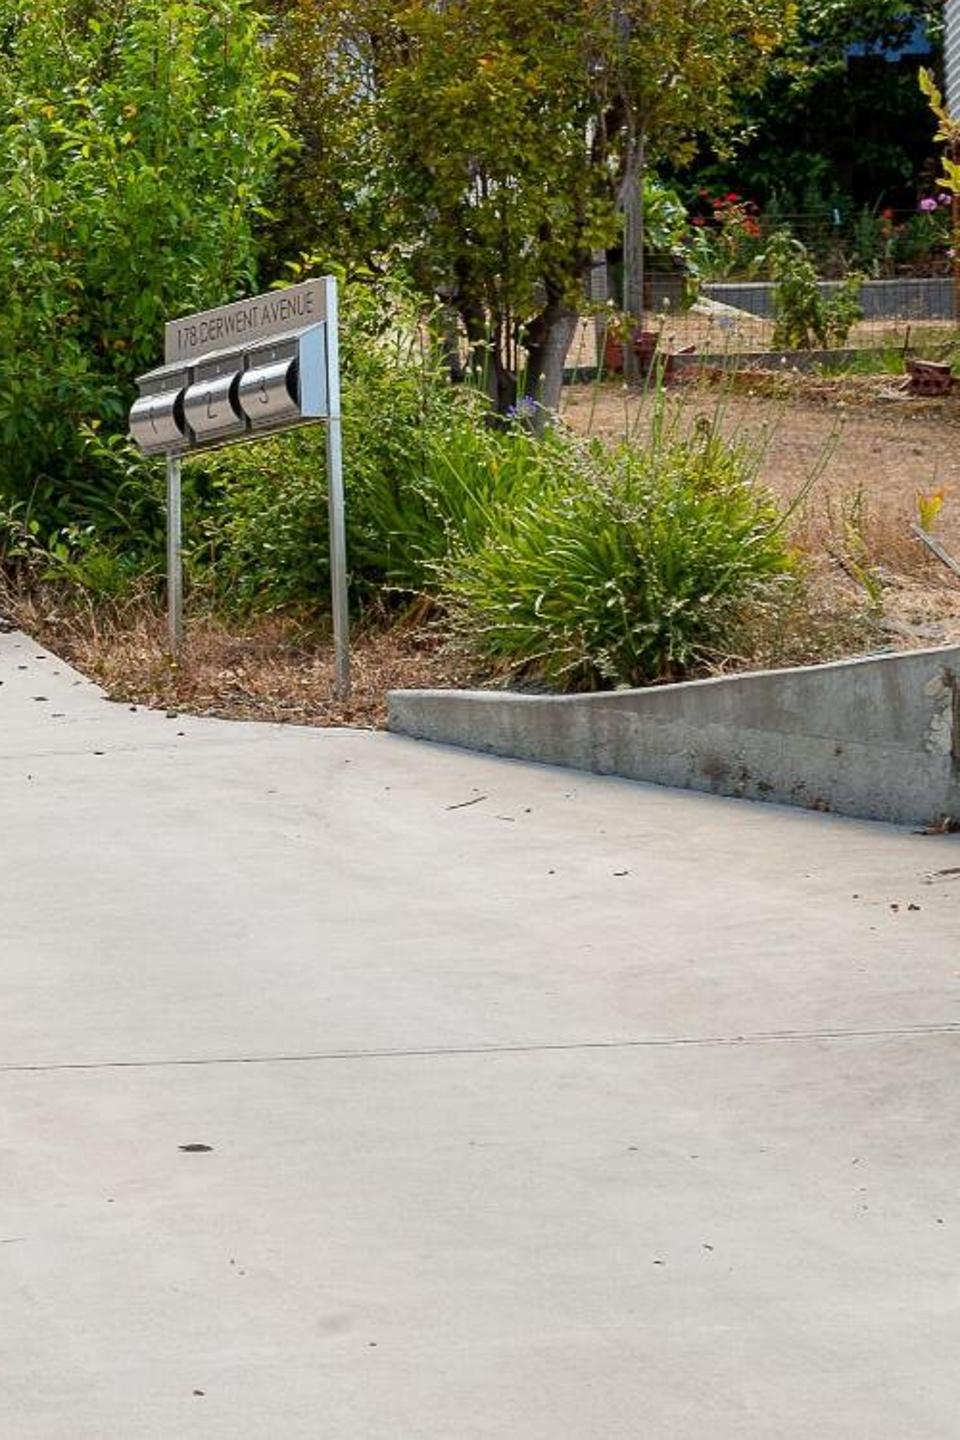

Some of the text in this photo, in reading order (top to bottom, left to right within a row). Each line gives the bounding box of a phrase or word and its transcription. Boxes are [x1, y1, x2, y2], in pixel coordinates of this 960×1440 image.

[177, 291, 314, 350] 178 DERWENT AVENUE
[259, 376, 269, 404] 3
[206, 392, 218, 420] 2
